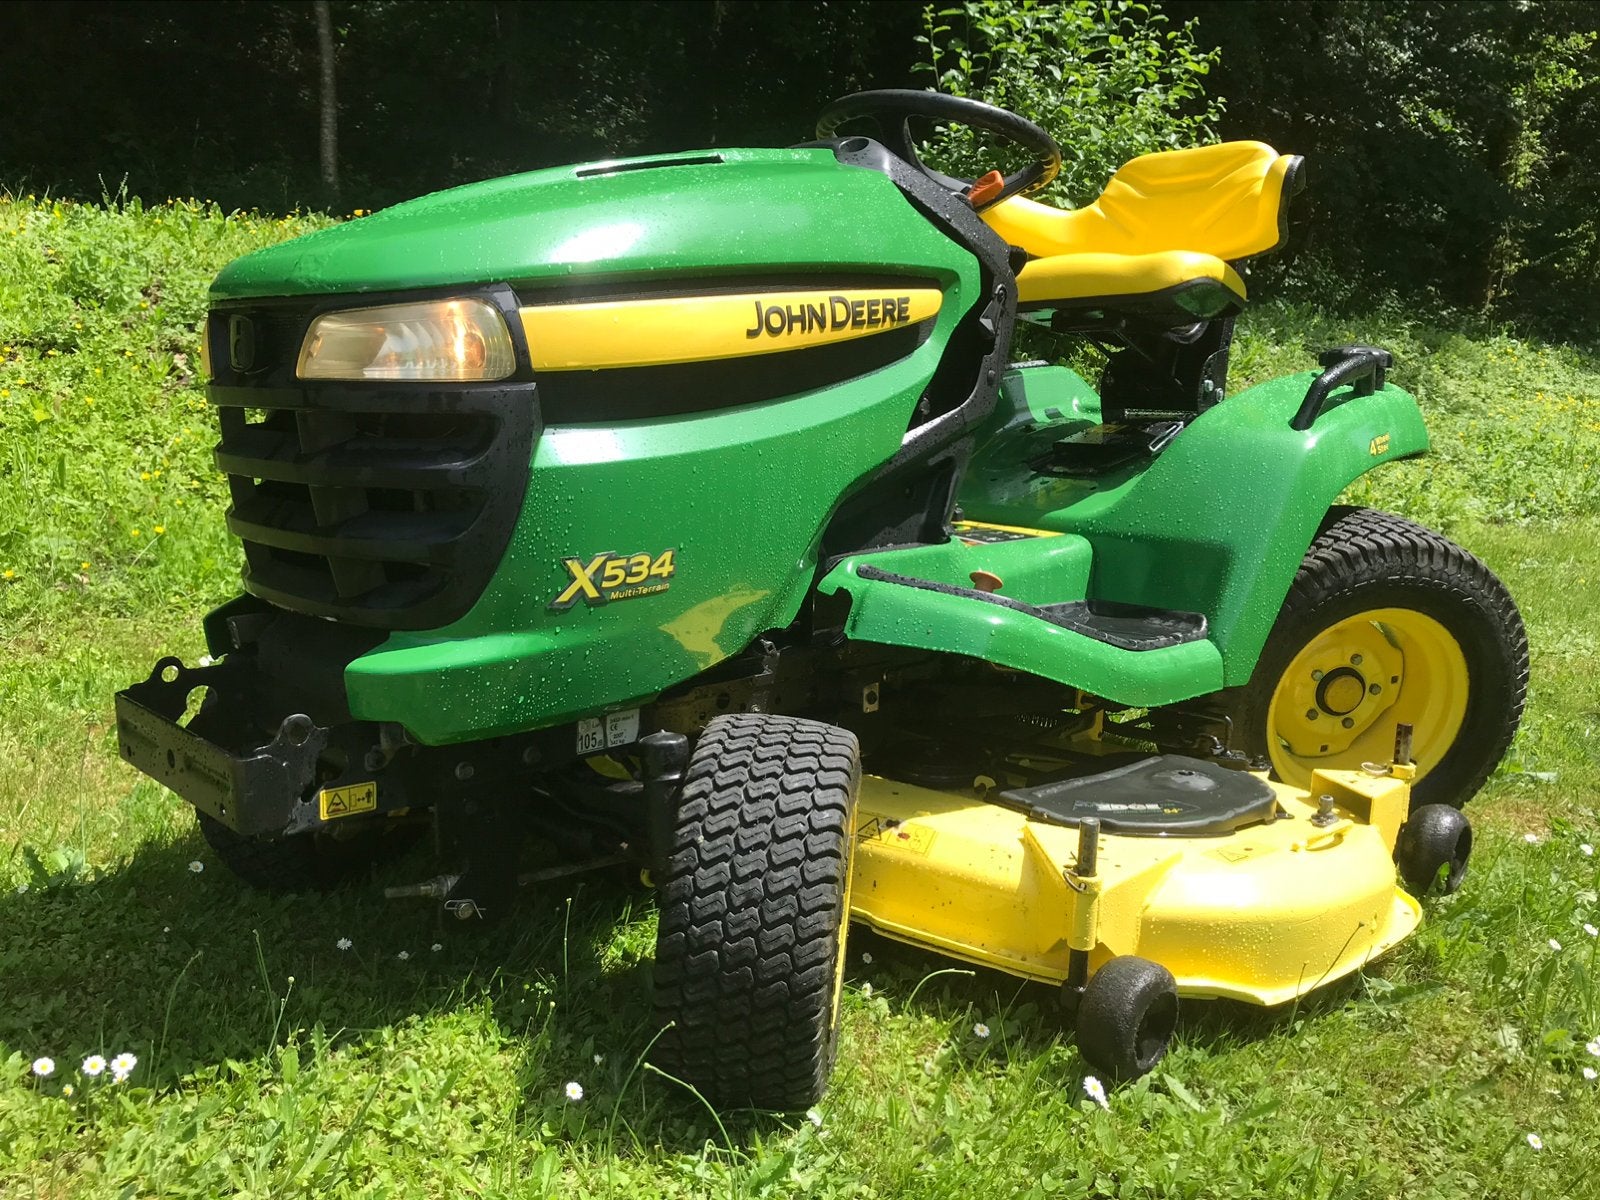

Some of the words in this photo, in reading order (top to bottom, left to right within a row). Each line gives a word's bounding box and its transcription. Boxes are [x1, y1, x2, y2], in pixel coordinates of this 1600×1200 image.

[746, 300, 826, 339] JOHN
[829, 296, 911, 330] DEERE
[553, 550, 675, 604] X534
[610, 583, 670, 600] Multi-Terrain
[578, 732, 597, 750] 105
